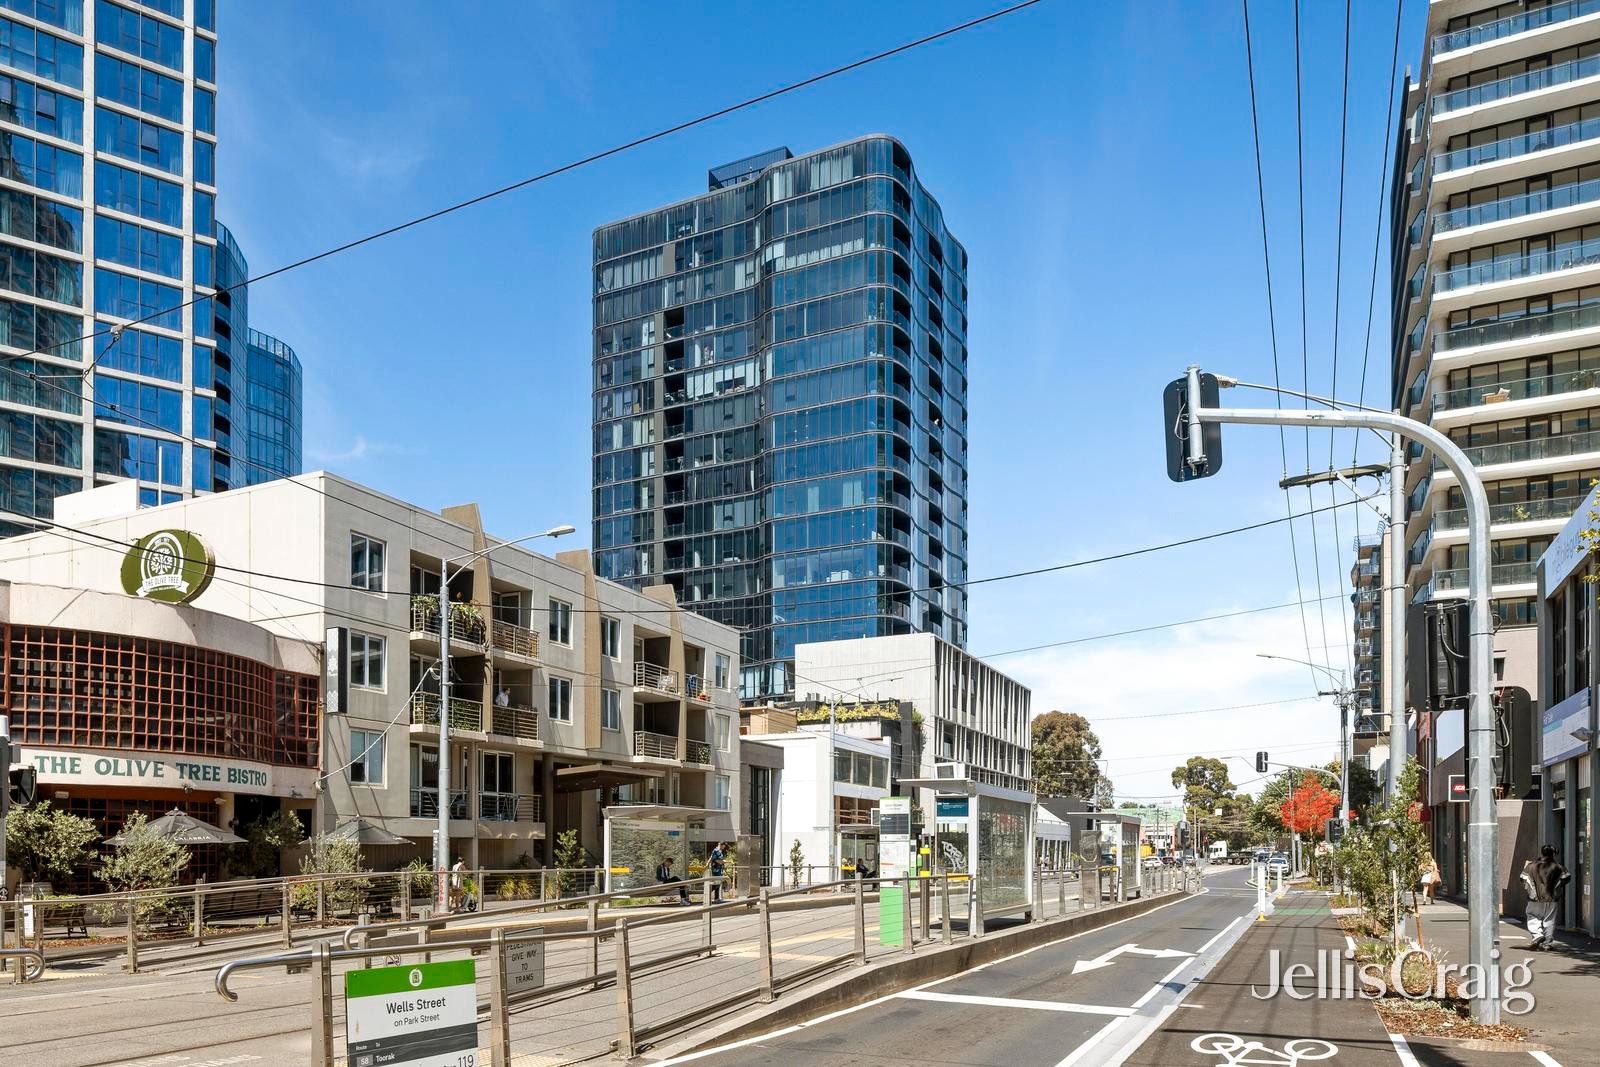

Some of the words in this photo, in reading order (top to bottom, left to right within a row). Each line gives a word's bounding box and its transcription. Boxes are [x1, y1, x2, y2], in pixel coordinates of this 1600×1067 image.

[154, 576, 167, 585] OLIVE
[168, 576, 179, 584] TREE
[34, 755, 82, 775] THE
[94, 758, 165, 778] OLIVE
[175, 762, 221, 782] TREE
[227, 768, 268, 787] BISTRO
[511, 952, 525, 962] GIVE
[526, 949, 538, 959] WAY
[520, 963, 529, 971] TO
[515, 973, 534, 984] TRAMS
[386, 1001, 414, 1015] Wells
[417, 996, 446, 1011] Street
[394, 1019, 403, 1027] on
[403, 1016, 418, 1026] Park
[420, 1013, 440, 1024] Street
[375, 1053, 395, 1062] Toorak
[457, 1054, 474, 1067] 119
